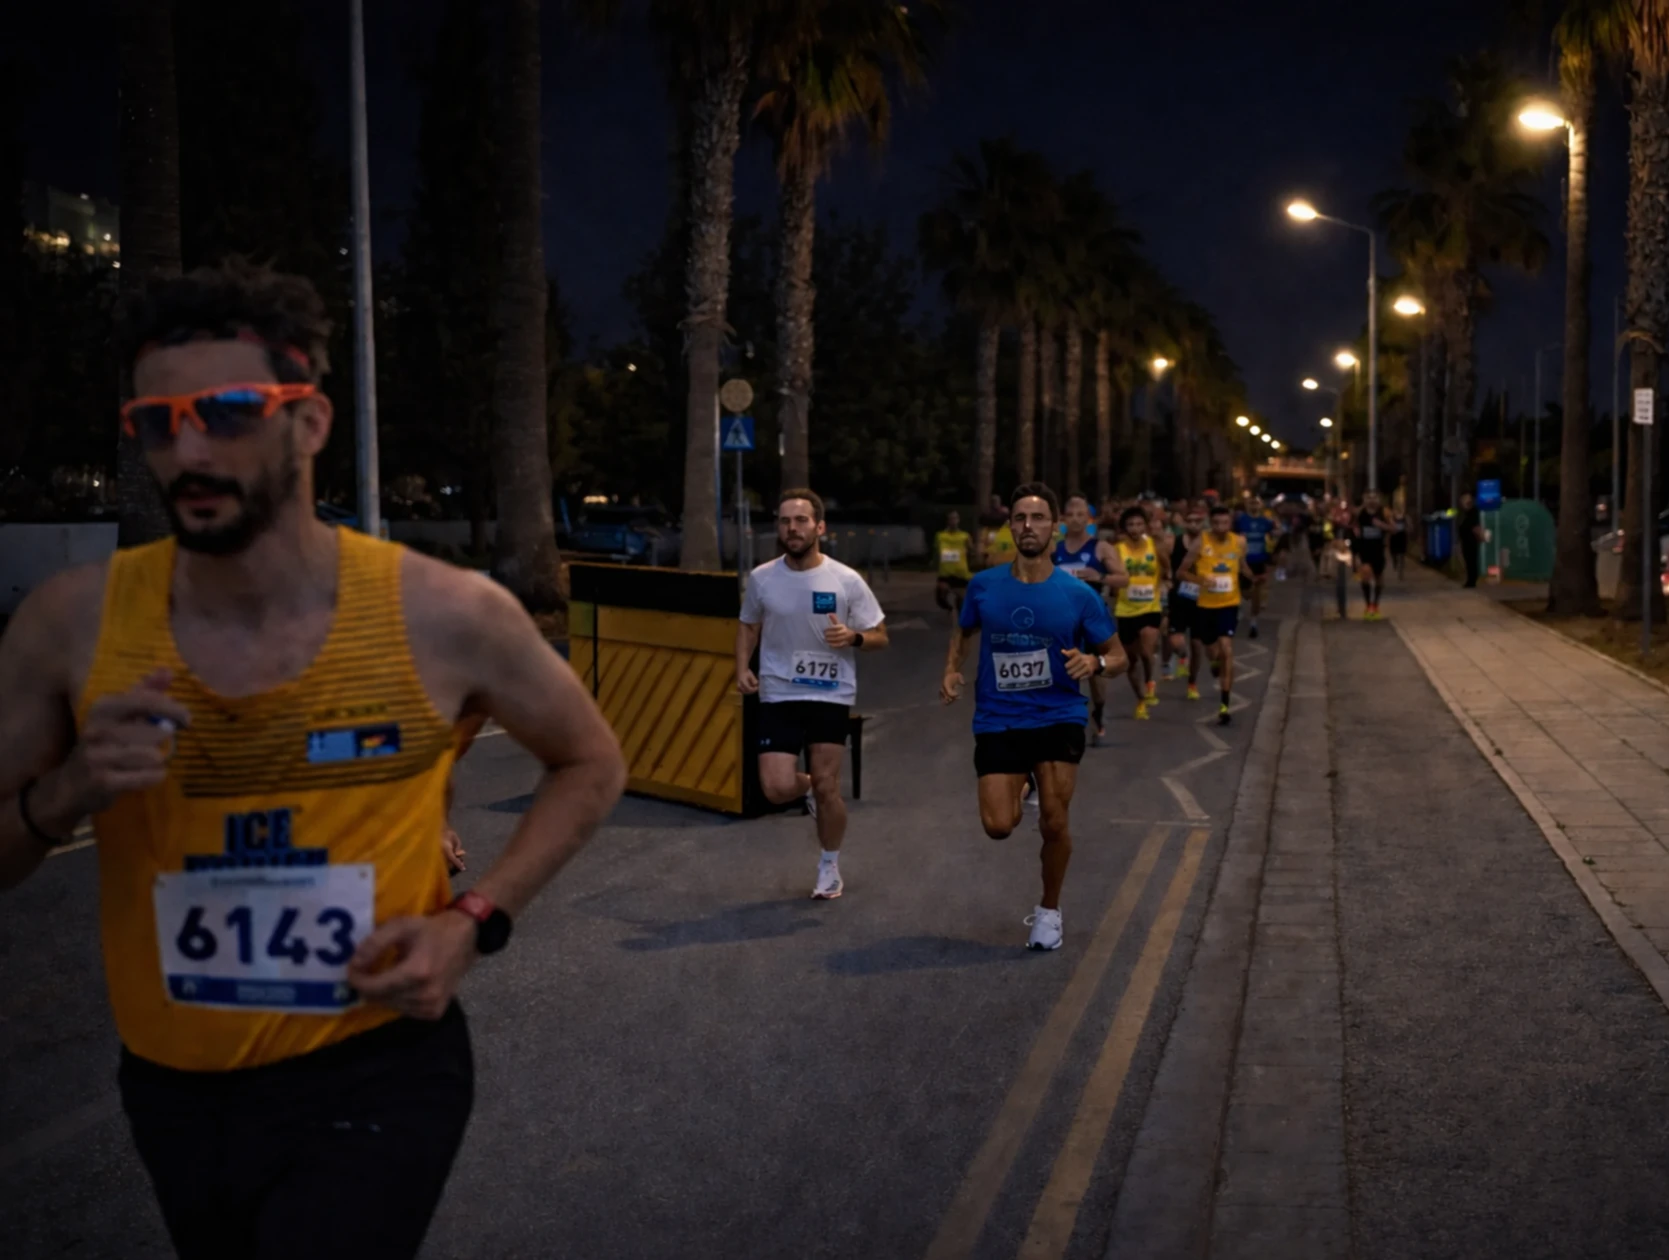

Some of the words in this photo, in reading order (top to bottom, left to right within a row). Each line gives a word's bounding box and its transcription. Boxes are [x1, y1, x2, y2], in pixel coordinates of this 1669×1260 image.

[1000, 660, 1045, 678] 6037
[226, 809, 292, 852] ICE
[177, 906, 355, 966] 6143
